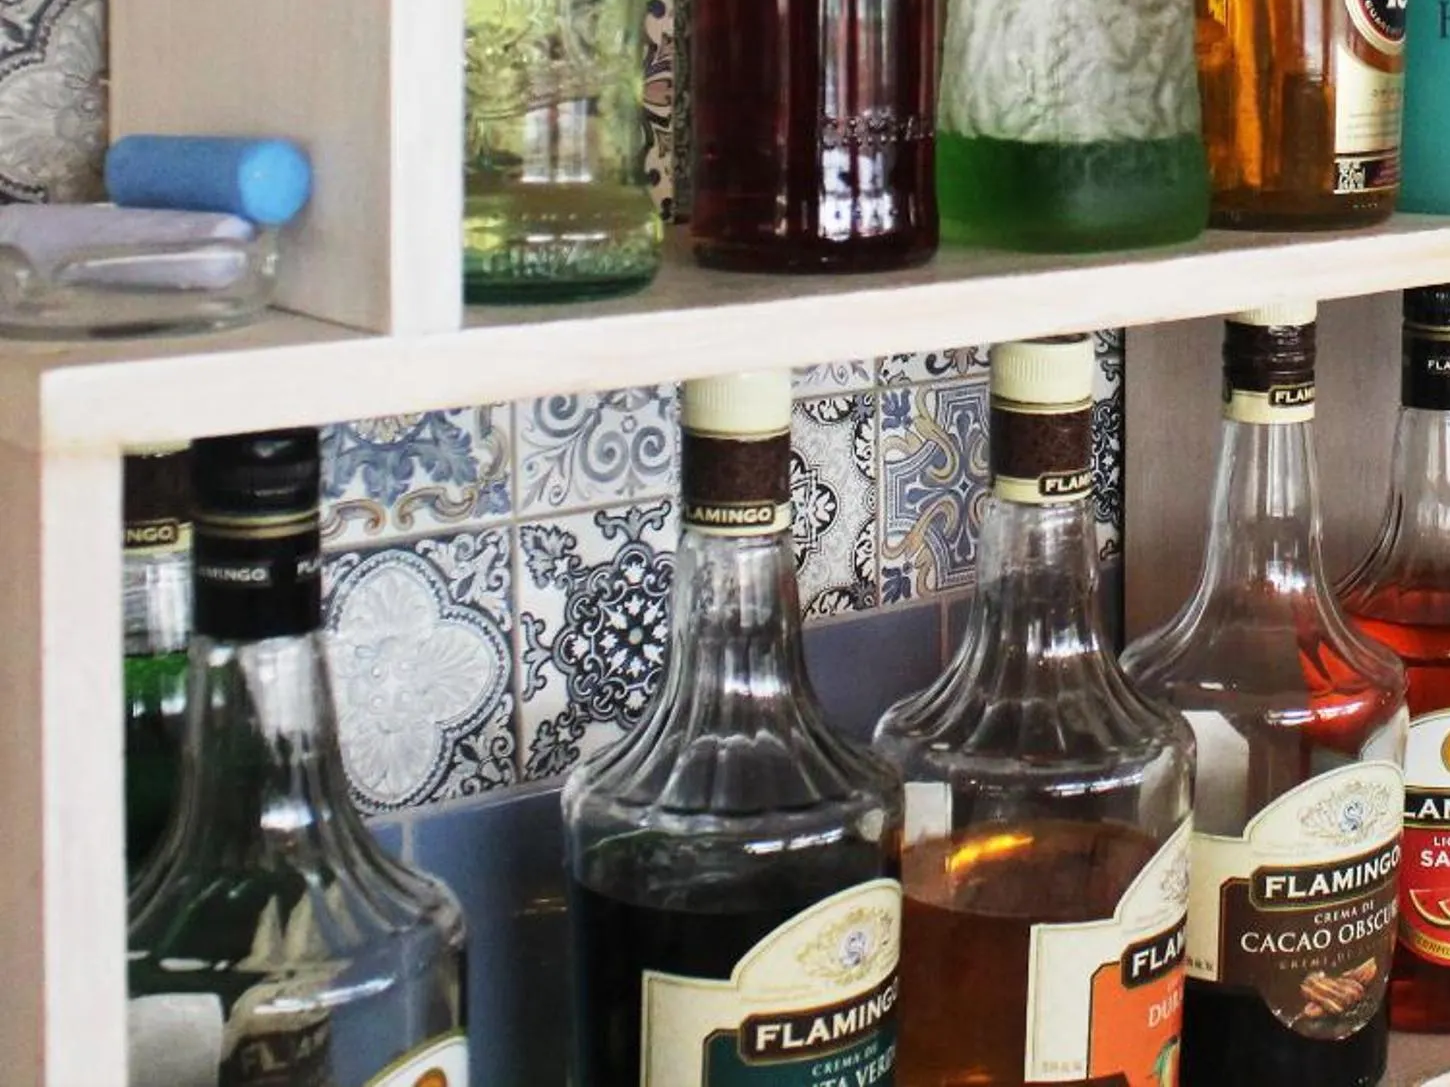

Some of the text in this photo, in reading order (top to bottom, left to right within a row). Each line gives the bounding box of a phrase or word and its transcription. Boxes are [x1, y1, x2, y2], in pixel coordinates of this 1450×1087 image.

[1265, 844, 1401, 899] FLAMINGO
[1313, 905, 1358, 925] CREMA
[1240, 928, 1332, 953] CACAO
